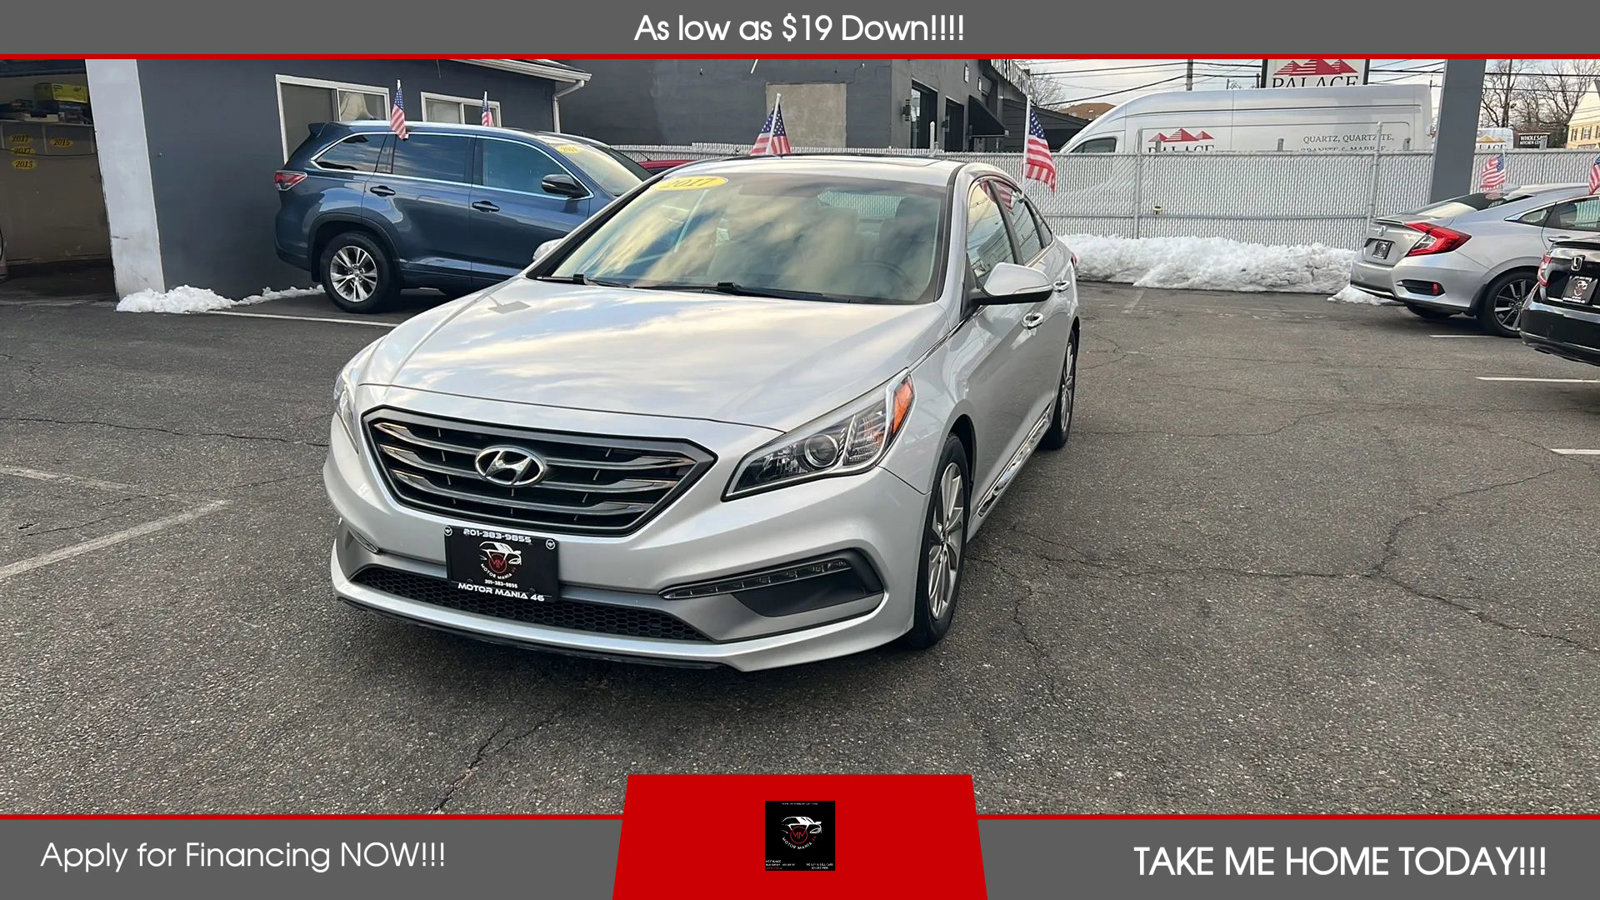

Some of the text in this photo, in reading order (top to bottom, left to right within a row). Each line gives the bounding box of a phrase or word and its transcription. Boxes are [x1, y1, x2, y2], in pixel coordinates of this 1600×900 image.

[1343, 133, 1395, 143] QUARTZTE,
[463, 528, 532, 543] 201-383-9855
[458, 582, 545, 602] MOTOR MANIA 46
